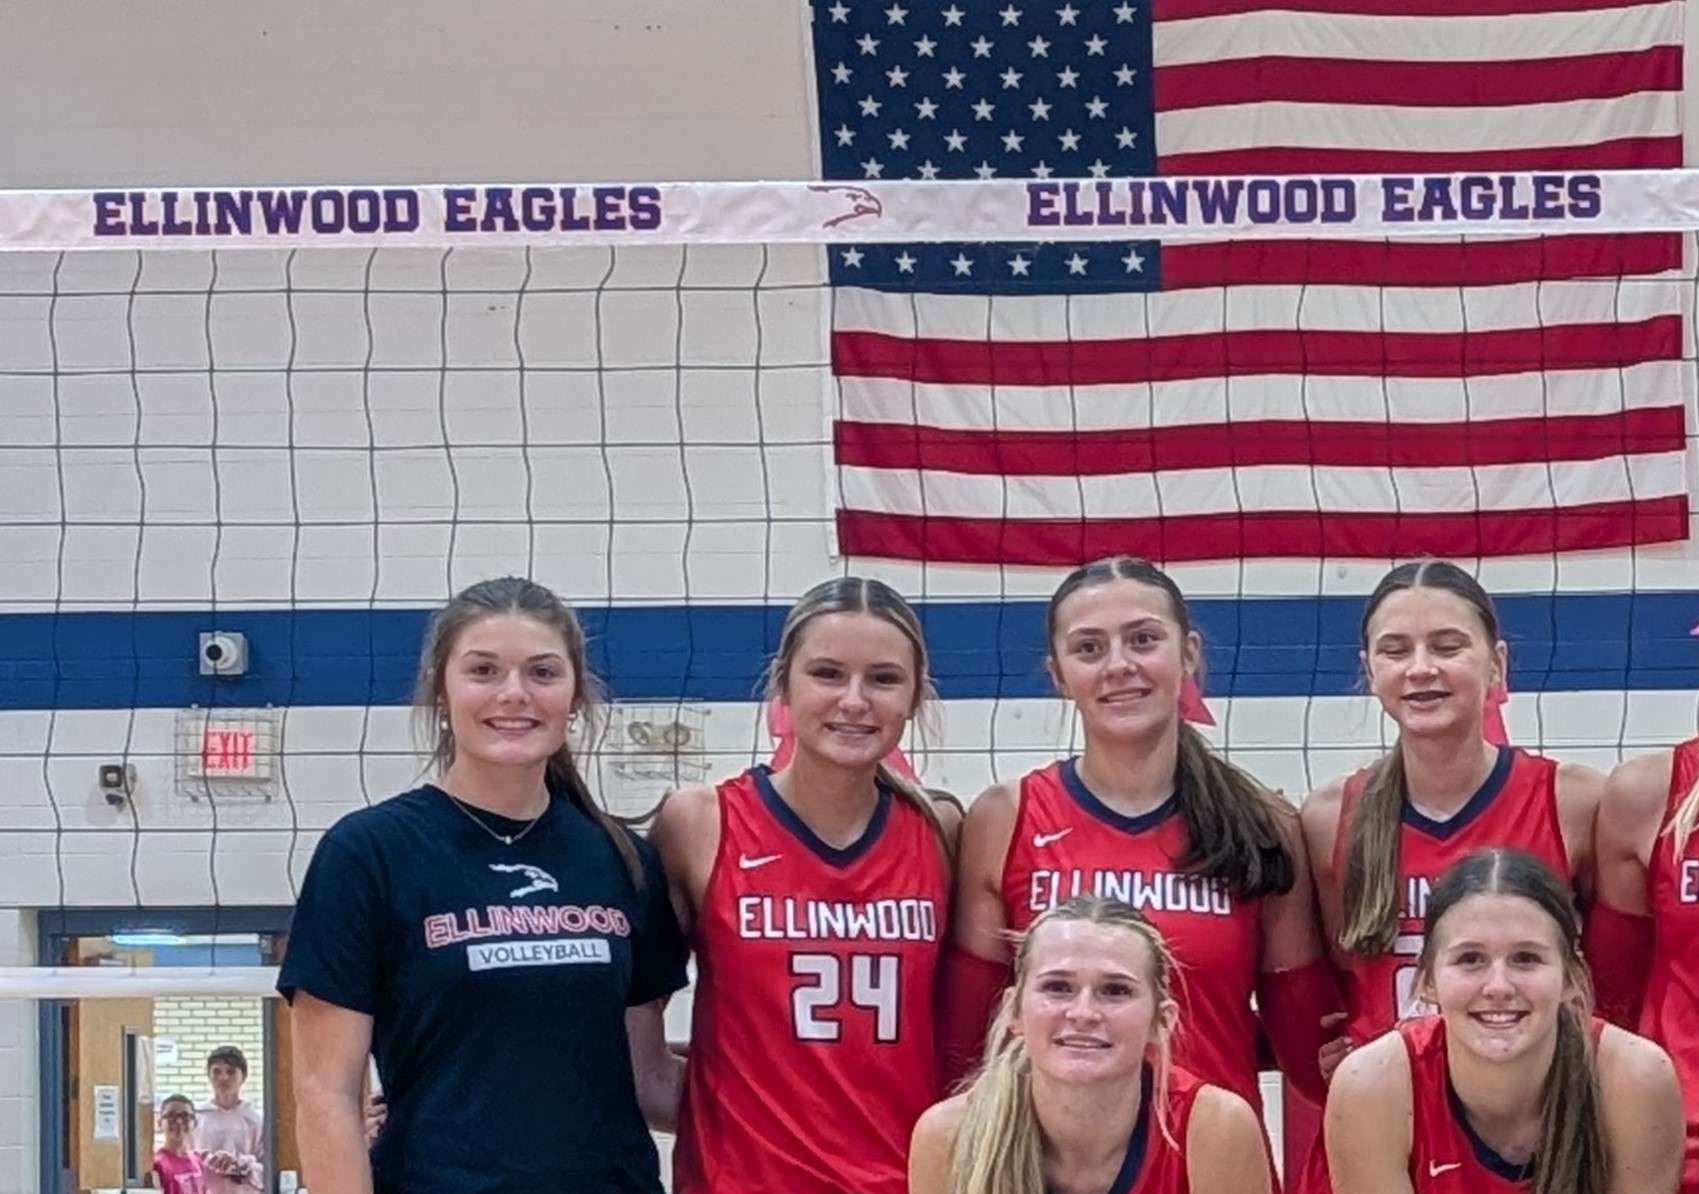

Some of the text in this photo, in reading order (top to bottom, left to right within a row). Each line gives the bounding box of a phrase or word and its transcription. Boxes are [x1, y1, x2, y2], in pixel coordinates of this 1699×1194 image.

[94, 186, 661, 236] ELLINWOOD EAGLES
[1026, 174, 1601, 226] ELLINWOOD EAGLES
[202, 730, 253, 769] EXIT
[424, 905, 632, 948] ELLINWOOD
[739, 897, 936, 942] ELLINWOOD
[479, 941, 602, 964] VOLLEYBALL
[792, 954, 899, 1041] 24
